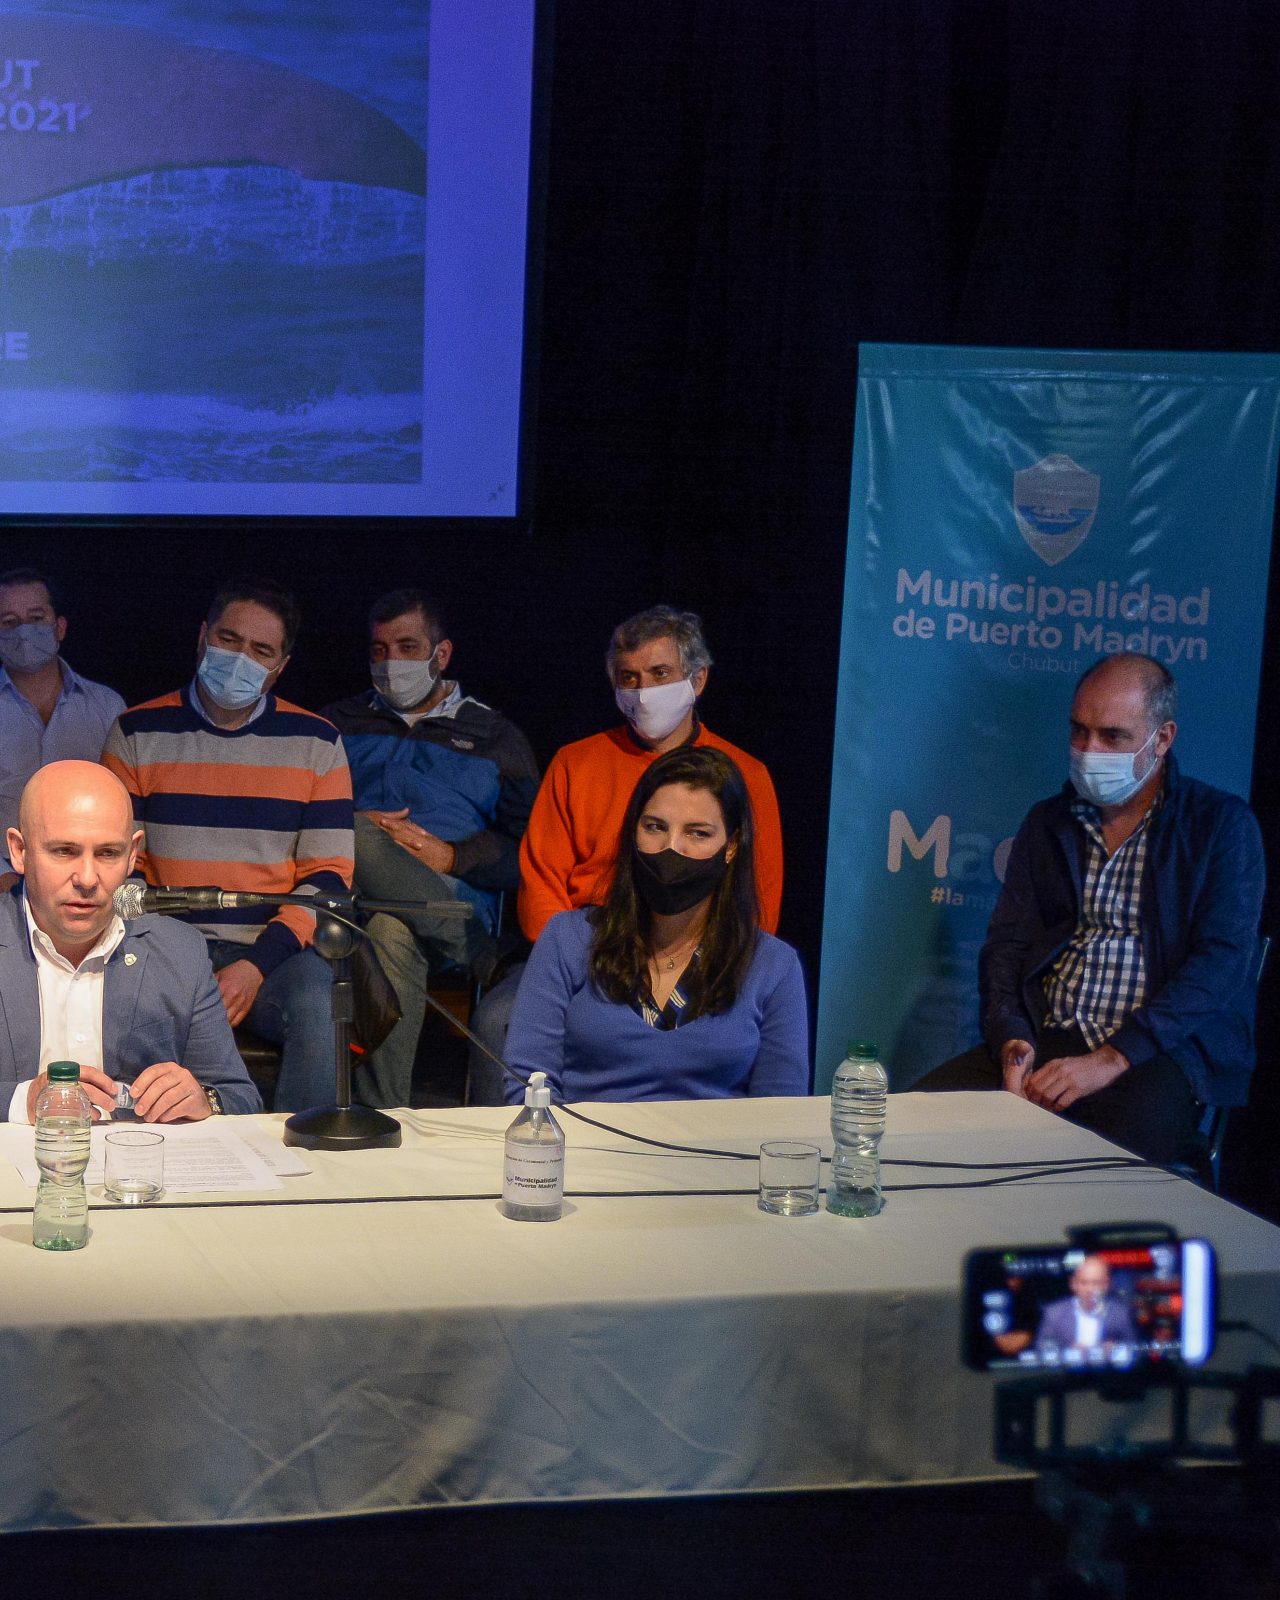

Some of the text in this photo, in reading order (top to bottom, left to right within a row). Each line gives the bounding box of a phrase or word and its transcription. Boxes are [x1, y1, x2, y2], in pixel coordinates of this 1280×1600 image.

[895, 567, 1211, 626] Municipalidad
[892, 608, 1209, 664] de Puerto Madryn
[1008, 652, 1080, 674] Chubut
